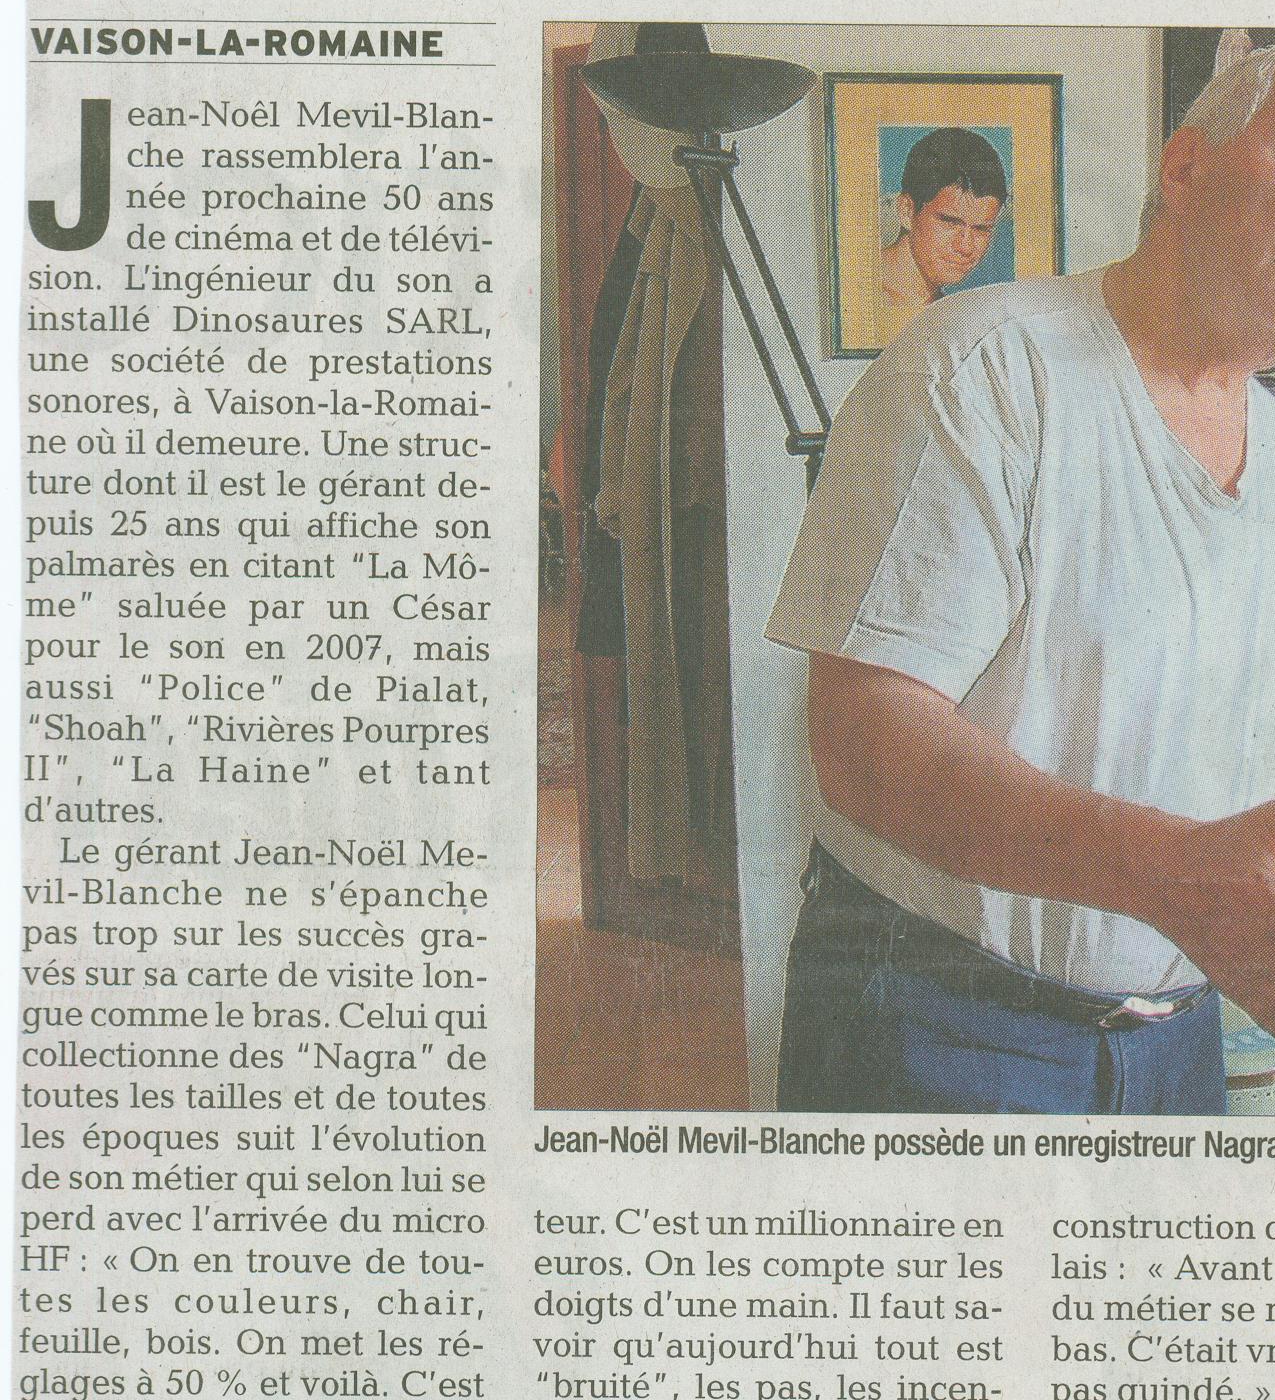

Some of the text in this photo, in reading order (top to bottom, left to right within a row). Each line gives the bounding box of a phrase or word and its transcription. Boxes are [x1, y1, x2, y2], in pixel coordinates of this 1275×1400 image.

[31, 27, 443, 57] VAISON-LA-ROMAINE
[297, 101, 493, 129] Mevil-Blan-
[126, 181, 494, 217] née prochaine 50 ans
[126, 223, 493, 252] de cinéma et de télévi-
[28, 304, 491, 339] installé Dinosaures SARL,
[534, 1125, 668, 1154] Jean-Noël
[678, 1126, 865, 1155] Mevil-Blanche
[874, 1127, 984, 1161] possède
[994, 1134, 1026, 1156] un
[1035, 1129, 1196, 1163] enregistreur
[1052, 1214, 1255, 1240] construction
[534, 1249, 1003, 1285] euros. On les compte sur les
